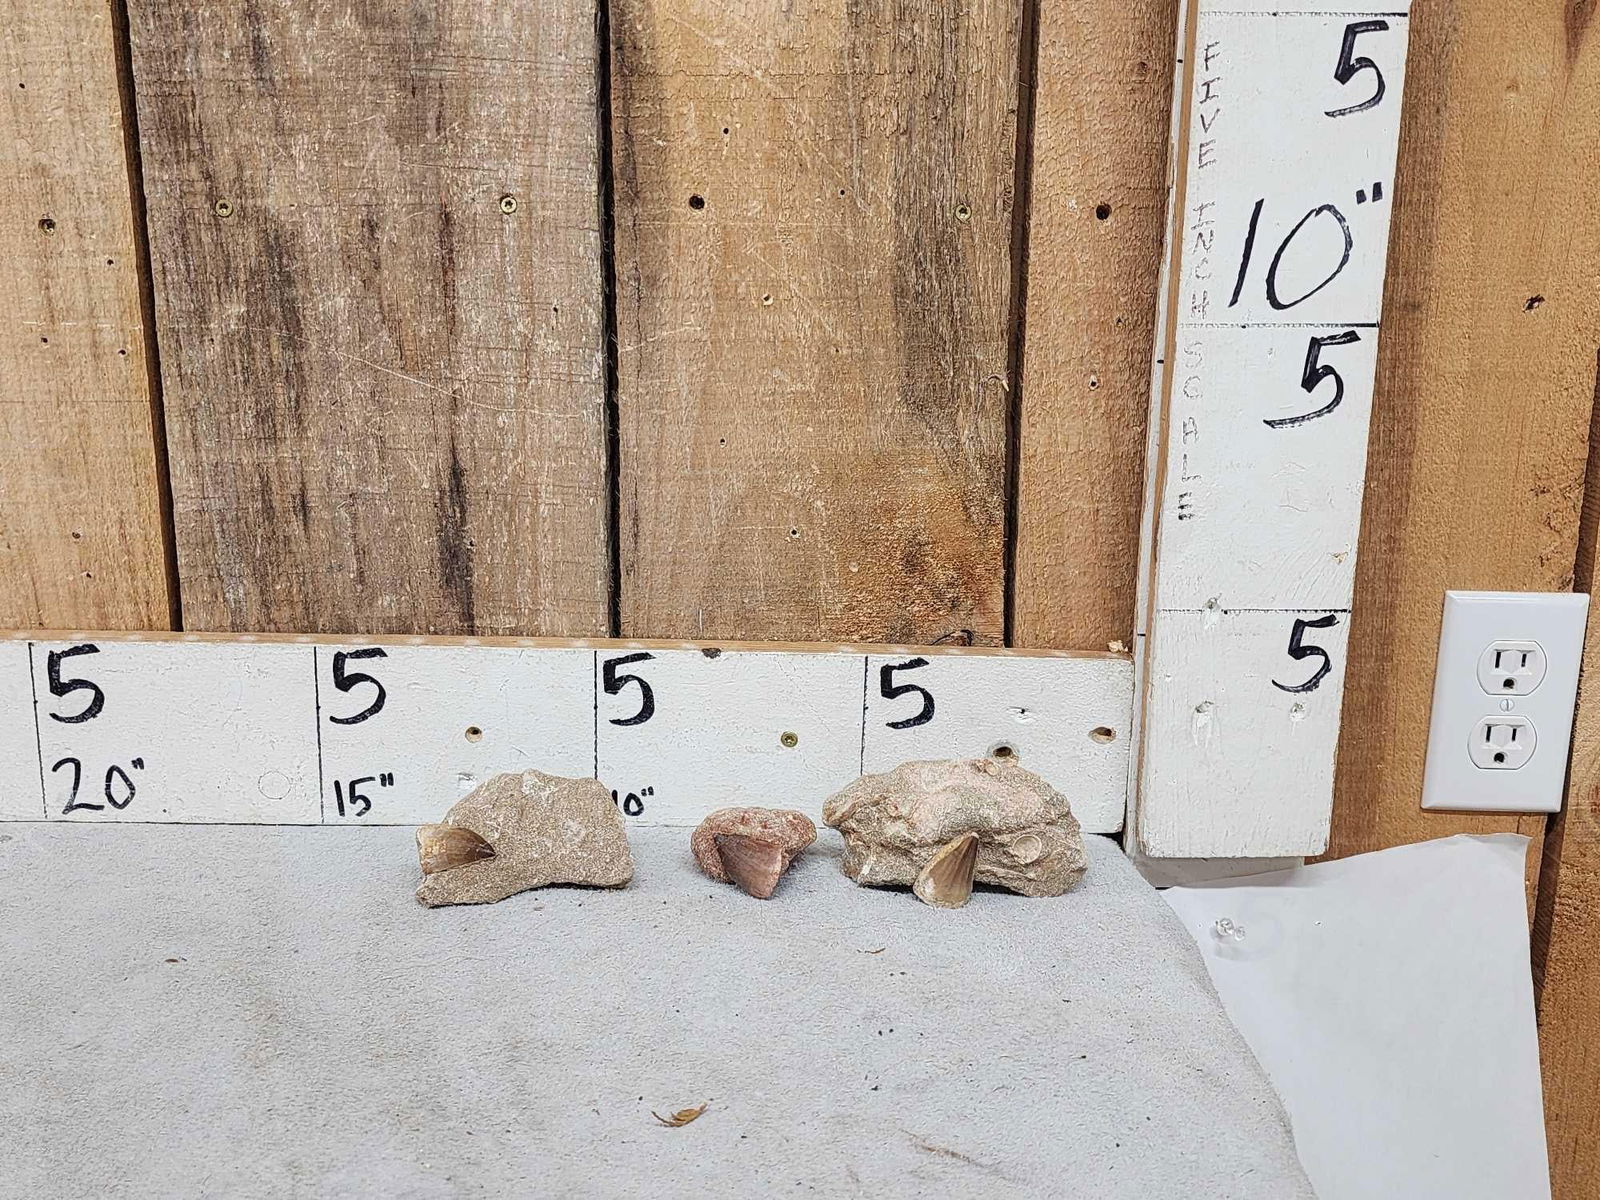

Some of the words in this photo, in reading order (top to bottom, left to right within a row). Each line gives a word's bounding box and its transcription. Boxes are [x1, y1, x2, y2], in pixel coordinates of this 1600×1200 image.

[1198, 40, 1221, 169] FIVE
[1324, 19, 1389, 118] 5
[1228, 181, 1383, 311] 10"
[1263, 330, 1362, 430] 5
[47, 643, 105, 724] 5
[329, 647, 388, 725] 5
[602, 652, 656, 726] 5
[880, 657, 935, 729] 5
[1272, 614, 1340, 693] 5
[51, 757, 145, 815] 20"
[333, 772, 394, 817] 15"
